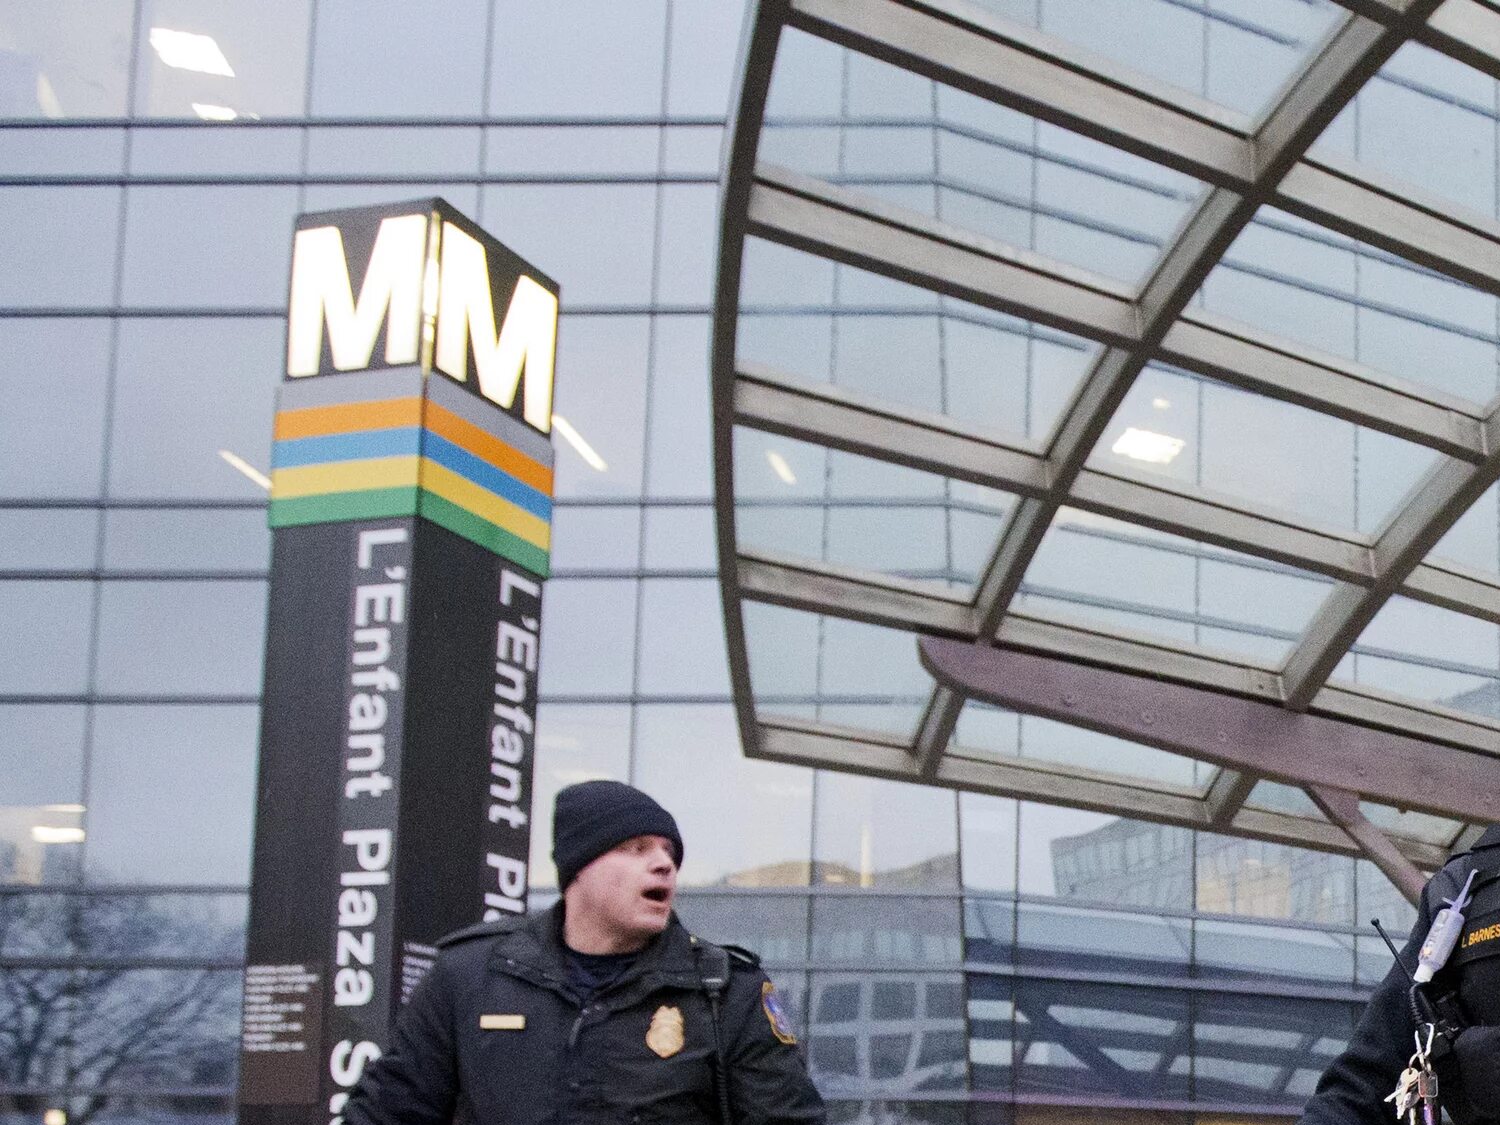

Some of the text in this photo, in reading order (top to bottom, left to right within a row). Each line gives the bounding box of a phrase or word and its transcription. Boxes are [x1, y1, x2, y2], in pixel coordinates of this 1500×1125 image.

[288, 214, 428, 378] M
[435, 219, 559, 435] M
[344, 528, 408, 800] L'Enfant
[483, 569, 541, 922] L'Enfant Pl
[333, 828, 394, 1008] Plaza
